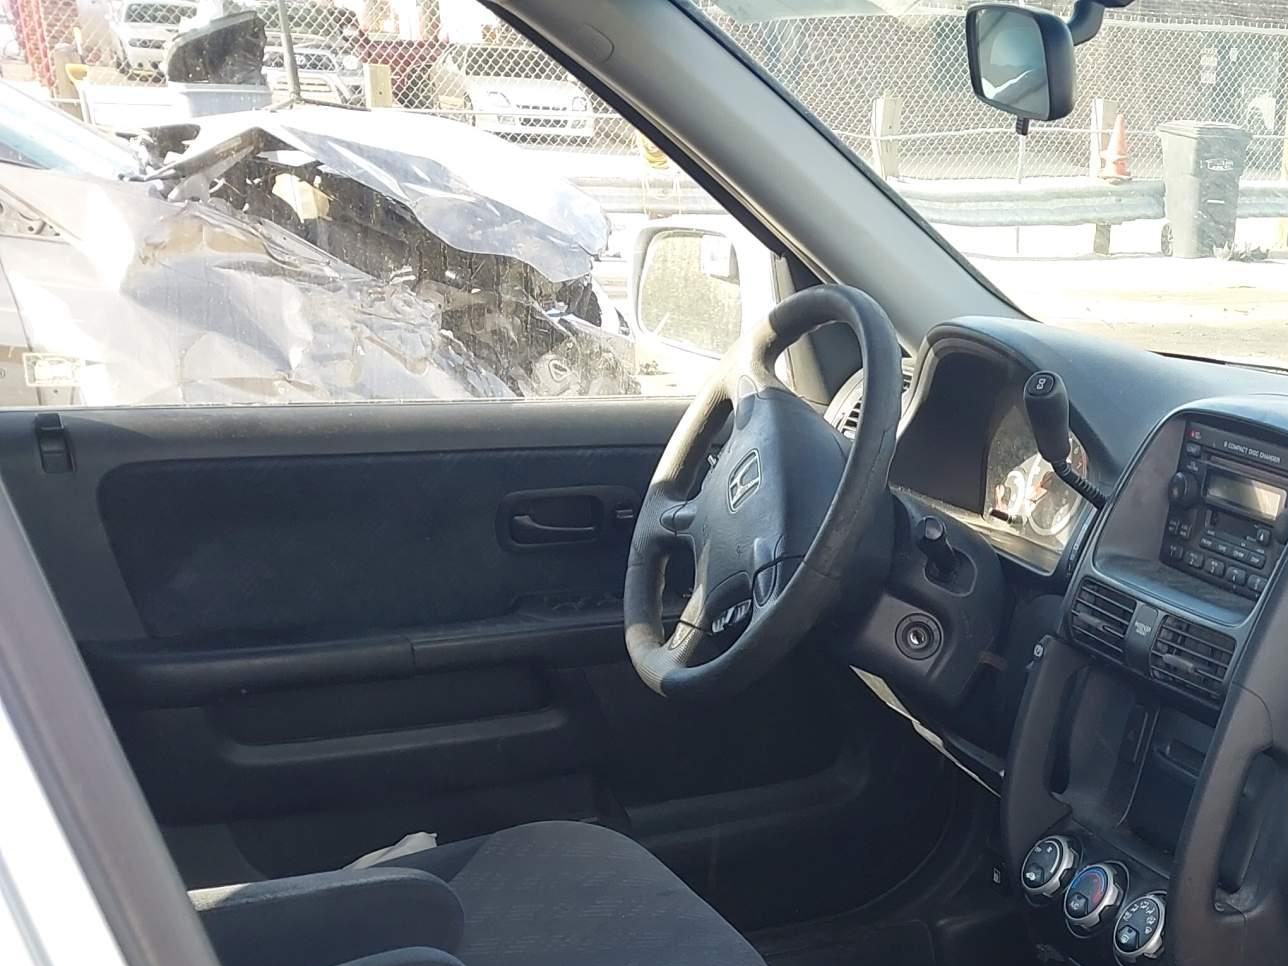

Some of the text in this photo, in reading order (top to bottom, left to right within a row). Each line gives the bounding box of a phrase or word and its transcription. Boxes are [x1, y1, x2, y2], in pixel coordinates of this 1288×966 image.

[1227, 441, 1248, 455] COMPACT
[1248, 447, 1259, 458] DISC
[1259, 449, 1281, 463] CHANGER
